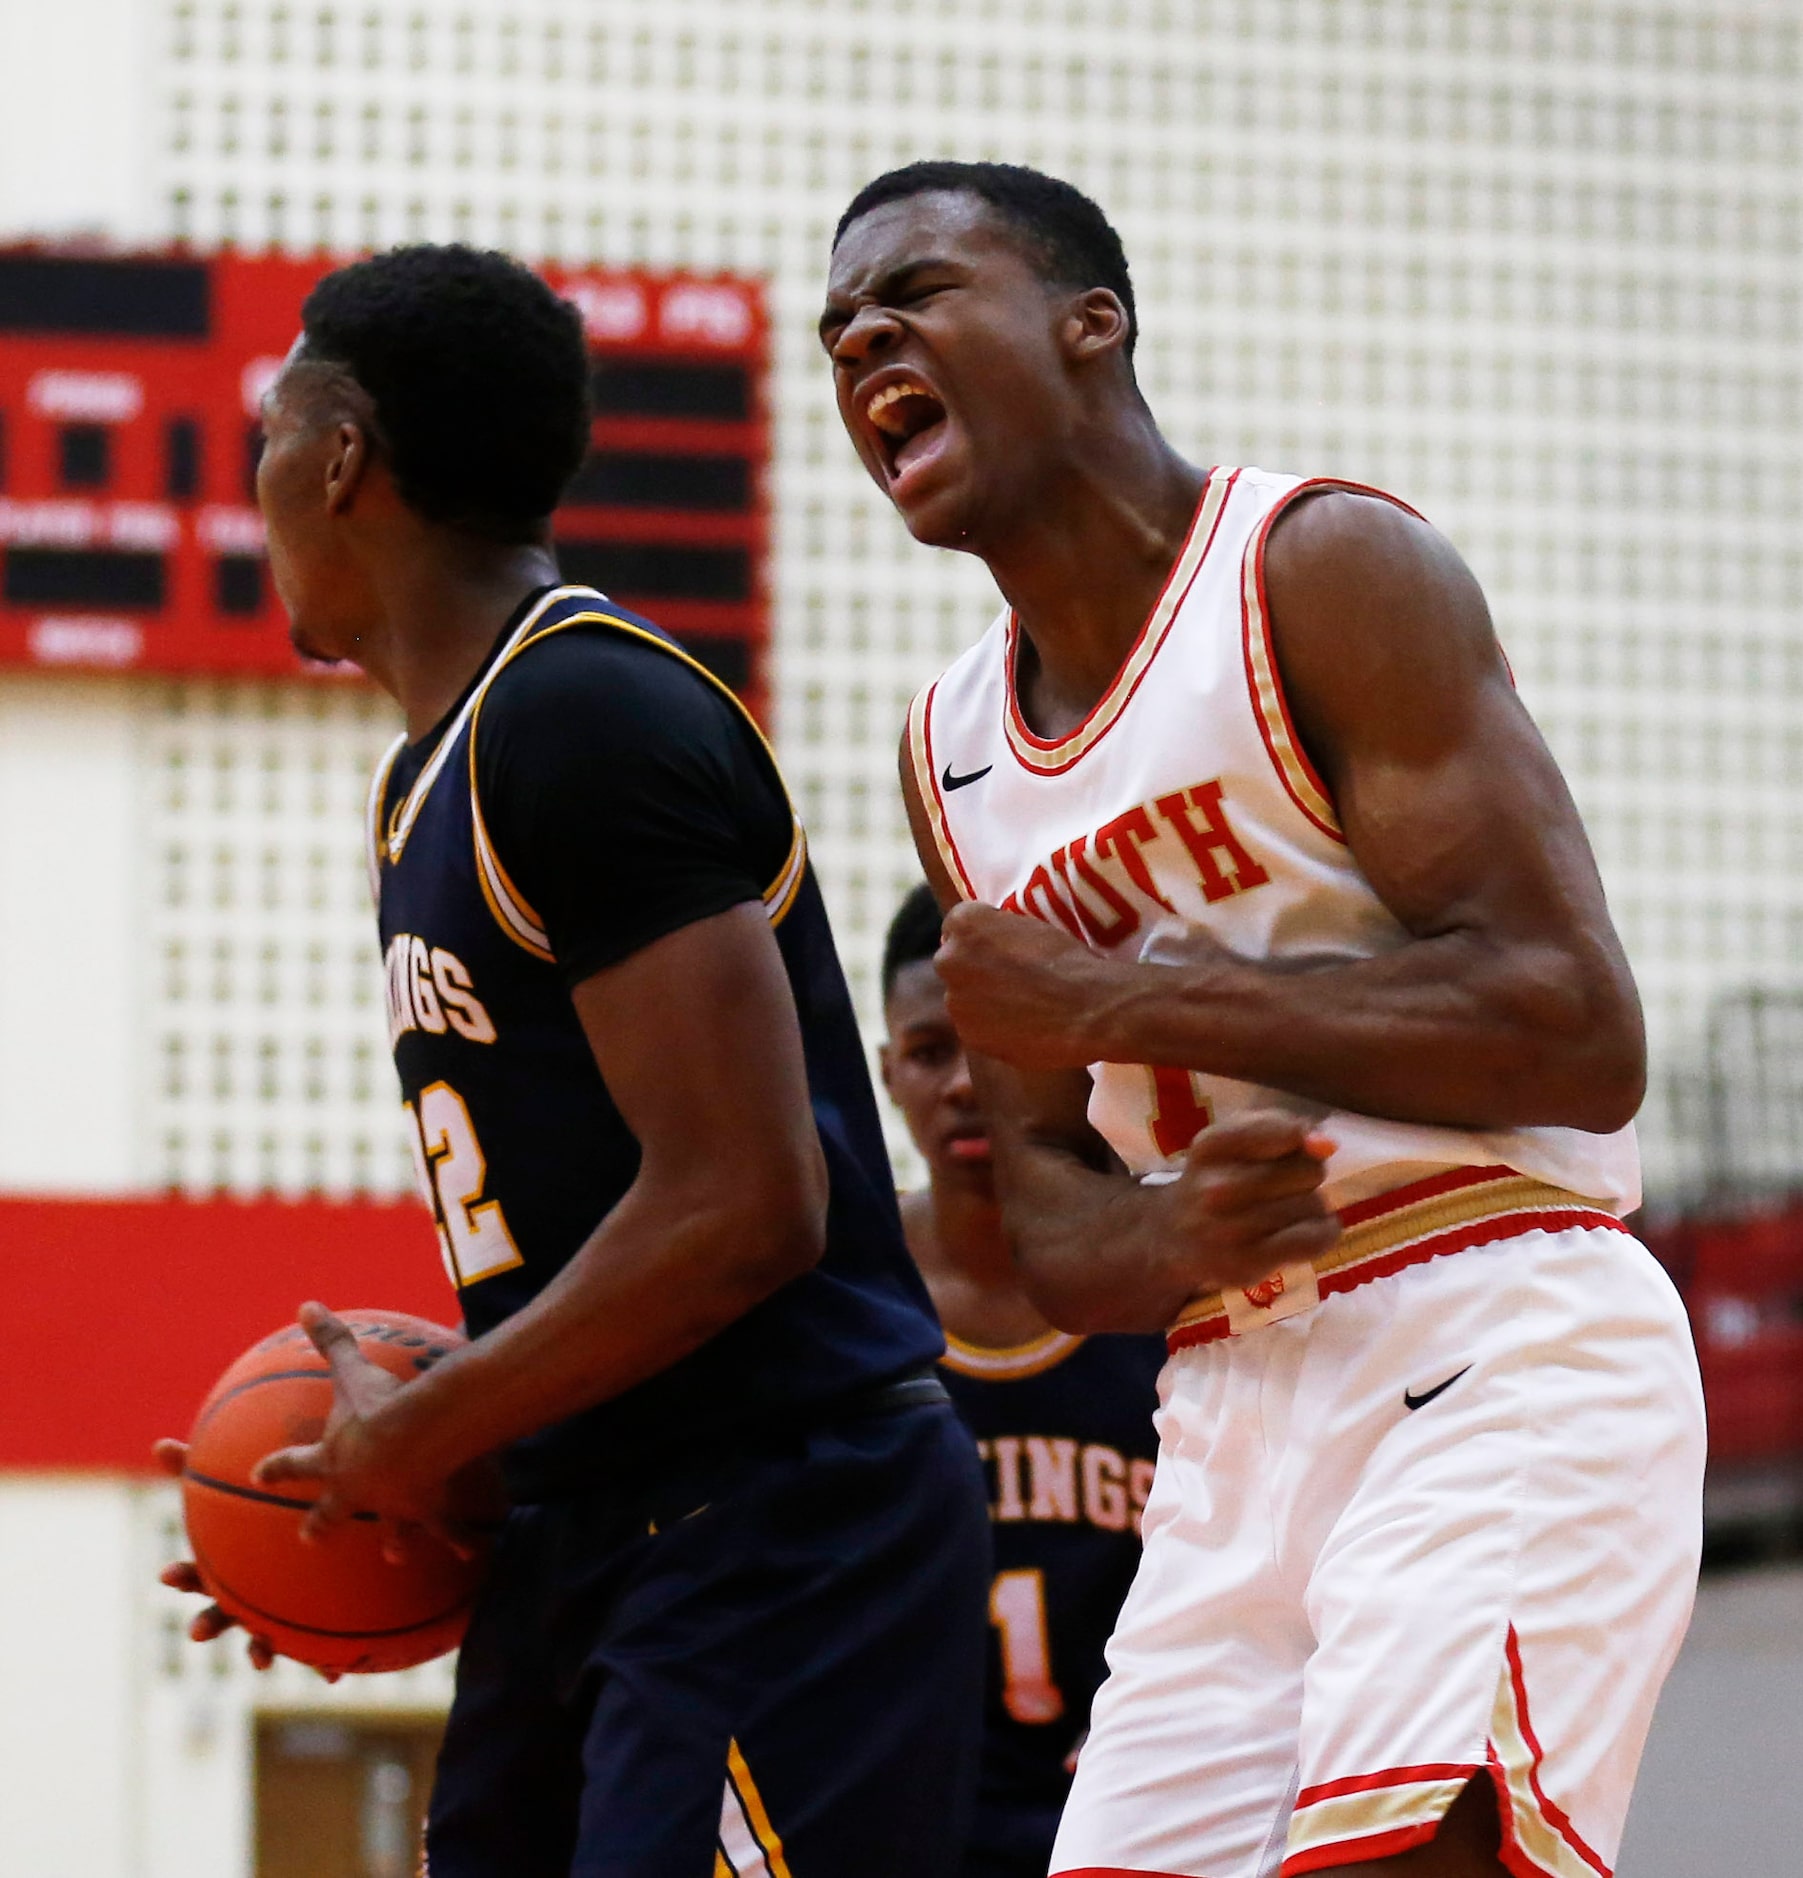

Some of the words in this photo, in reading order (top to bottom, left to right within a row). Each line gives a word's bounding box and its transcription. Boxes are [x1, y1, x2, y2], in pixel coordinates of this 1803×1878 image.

[999, 777, 1271, 948] OUTH
[403, 1079, 525, 1291] 2
[988, 1567, 1064, 1725] 1
